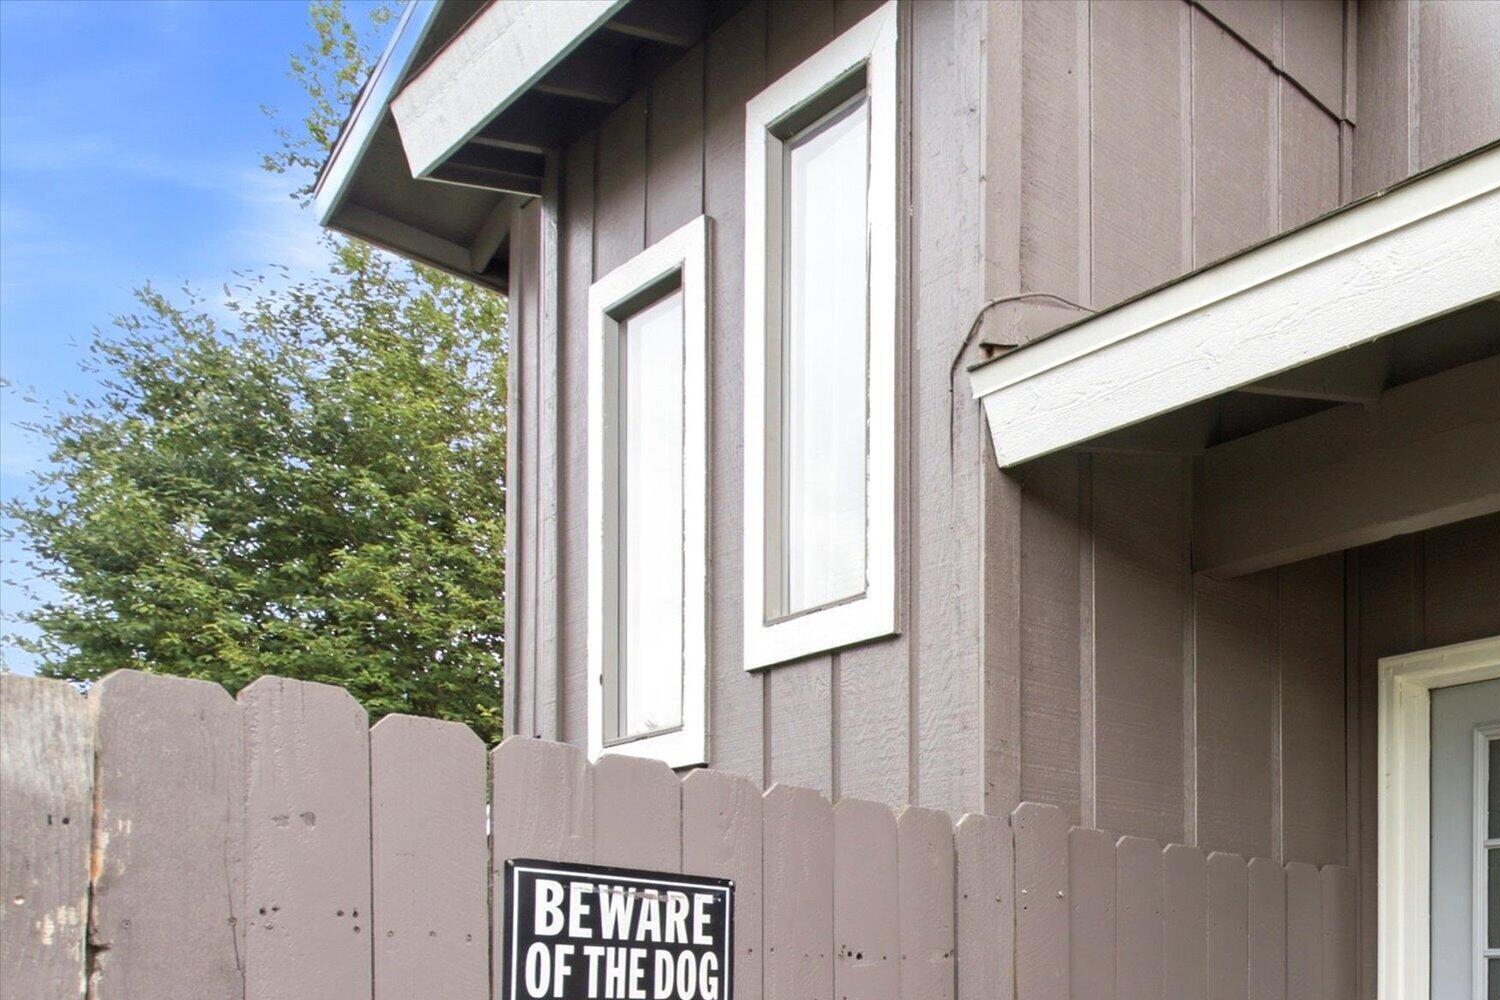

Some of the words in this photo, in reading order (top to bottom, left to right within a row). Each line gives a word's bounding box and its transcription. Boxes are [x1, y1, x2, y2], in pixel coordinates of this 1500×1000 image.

[534, 878, 714, 946] BEWARE
[525, 941, 575, 999] OF
[583, 945, 647, 1000] THE
[653, 949, 719, 1000] DOG
